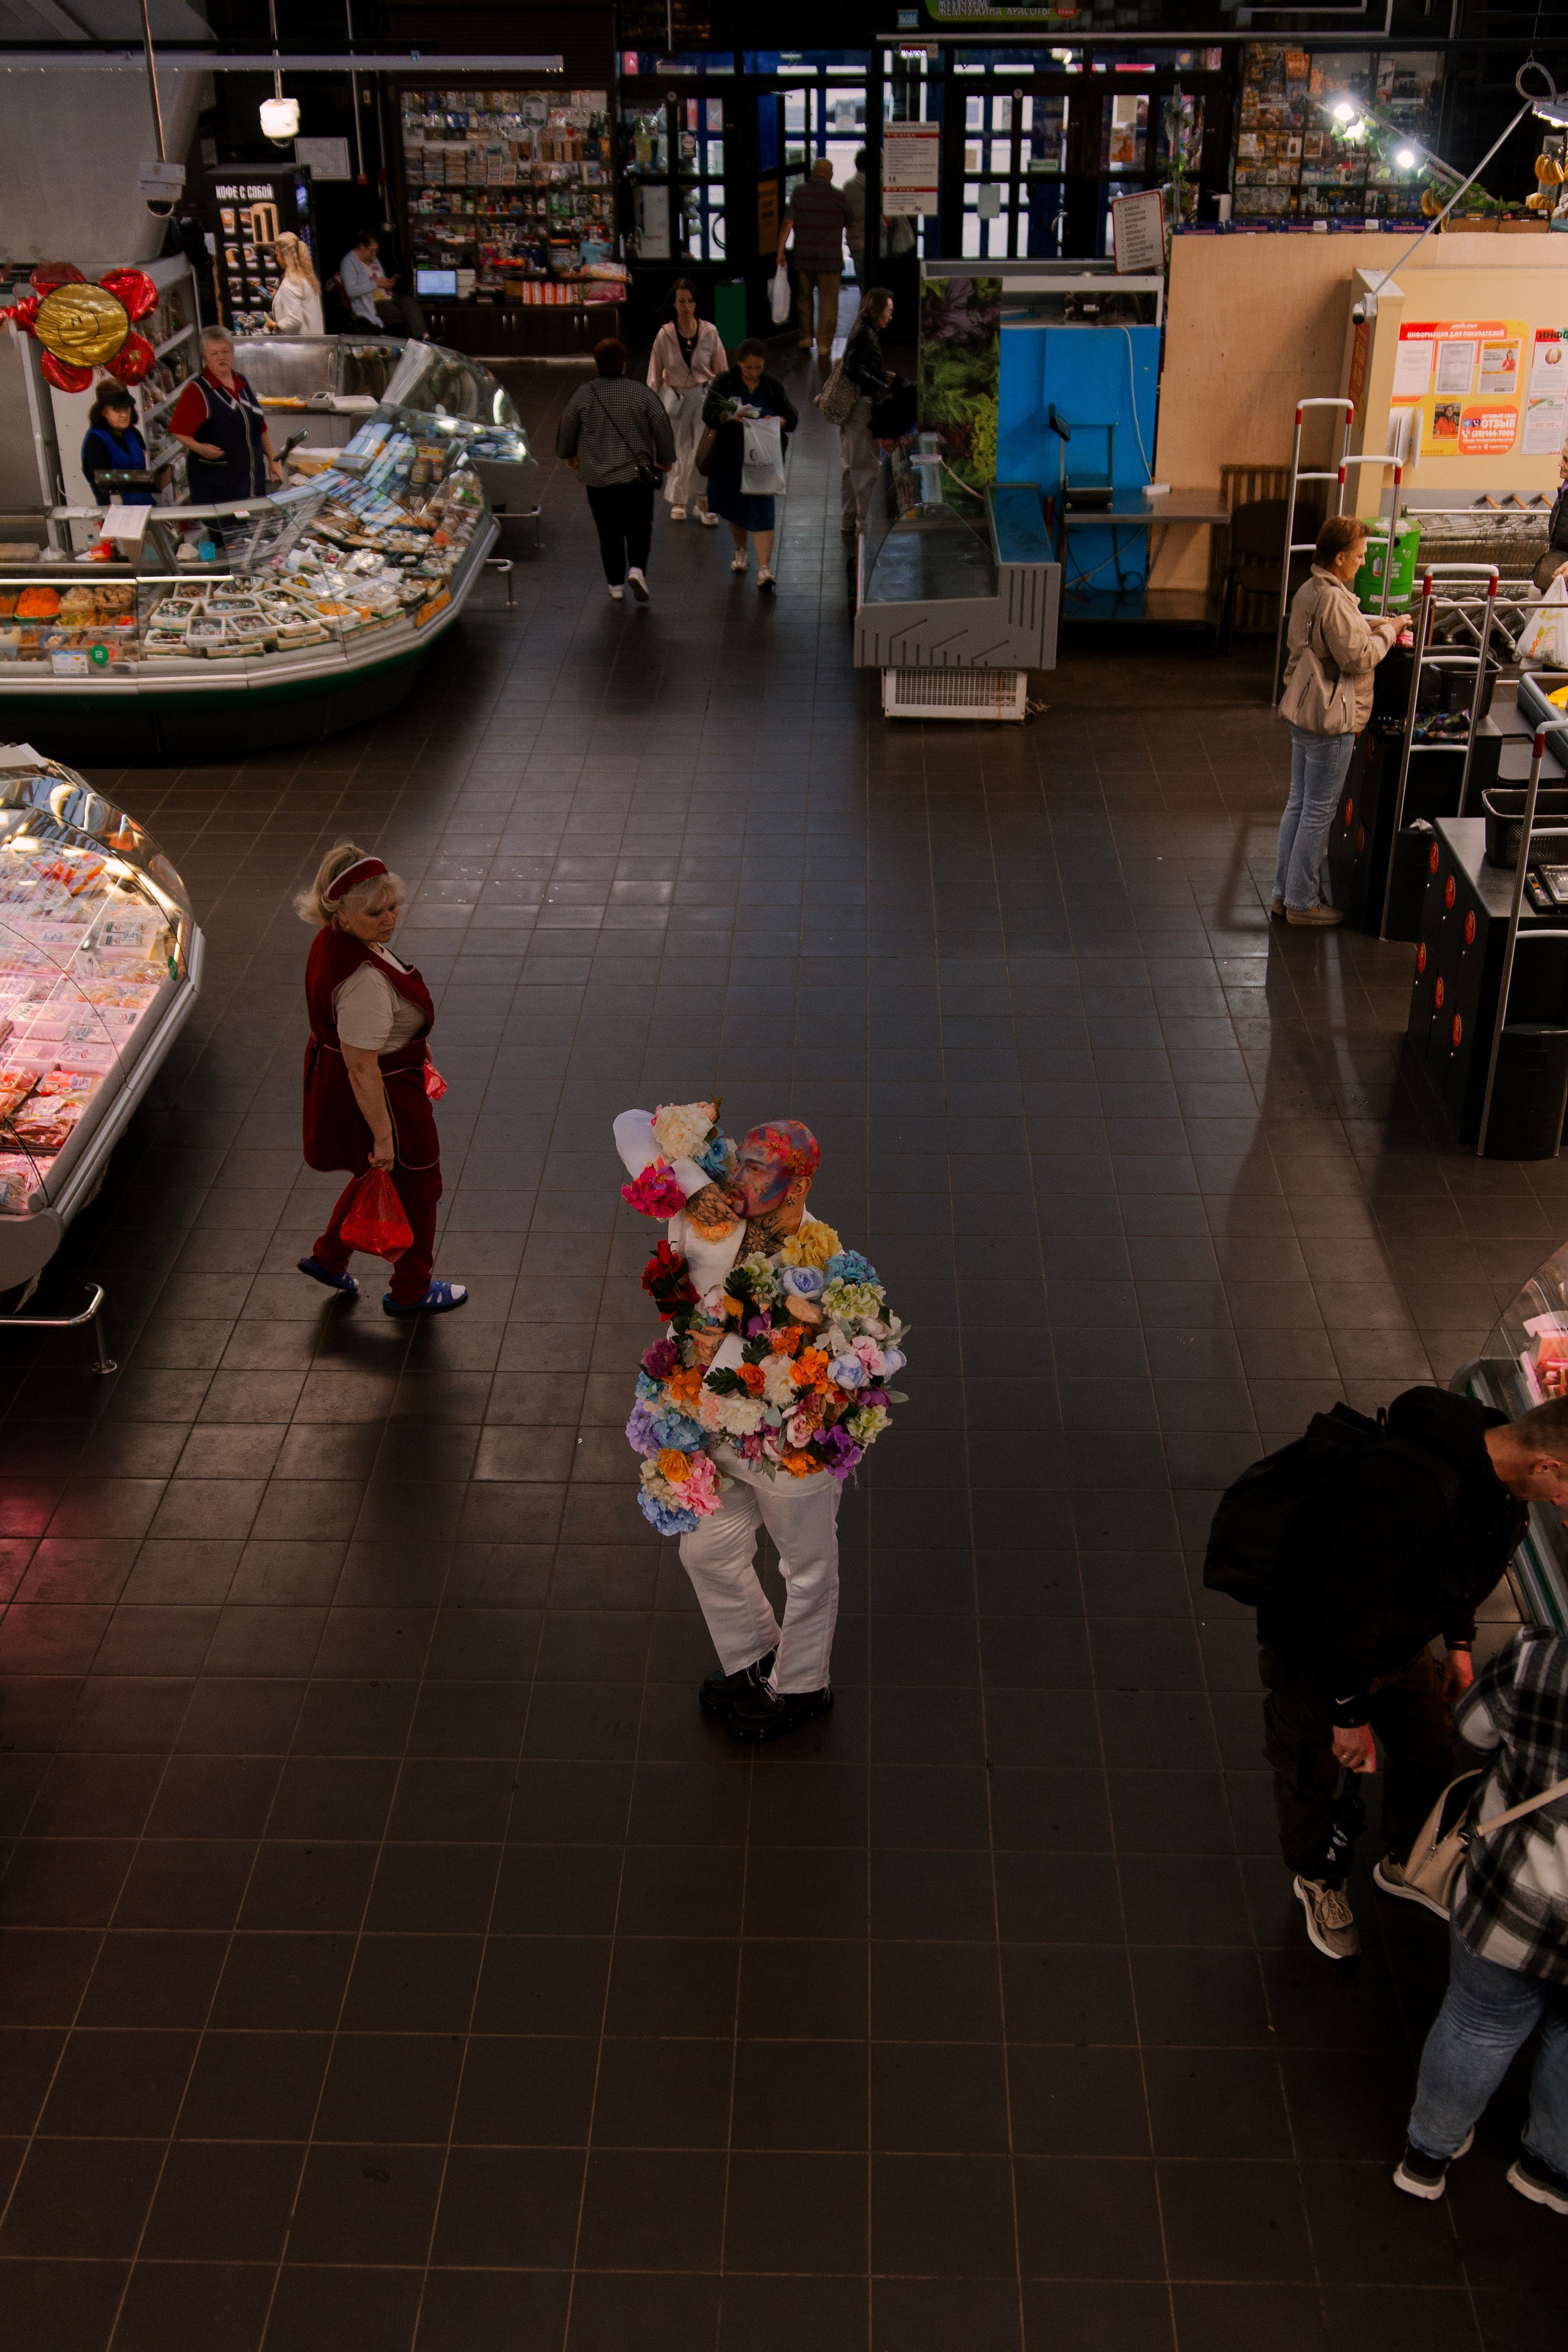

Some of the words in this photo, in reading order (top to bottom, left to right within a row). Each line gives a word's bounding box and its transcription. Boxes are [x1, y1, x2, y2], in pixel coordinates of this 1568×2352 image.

[938, 6, 1002, 17] ЖЕМЧУЖИНА
[1007, 7, 1050, 16] КРАСОТЫ
[216, 185, 239, 200] КОФЕ
[239, 185, 247, 200] С
[247, 183, 276, 200] СОБОЙ
[1539, 331, 1568, 339] ИНФО
[1481, 419, 1516, 429] ОТЗЫВ
